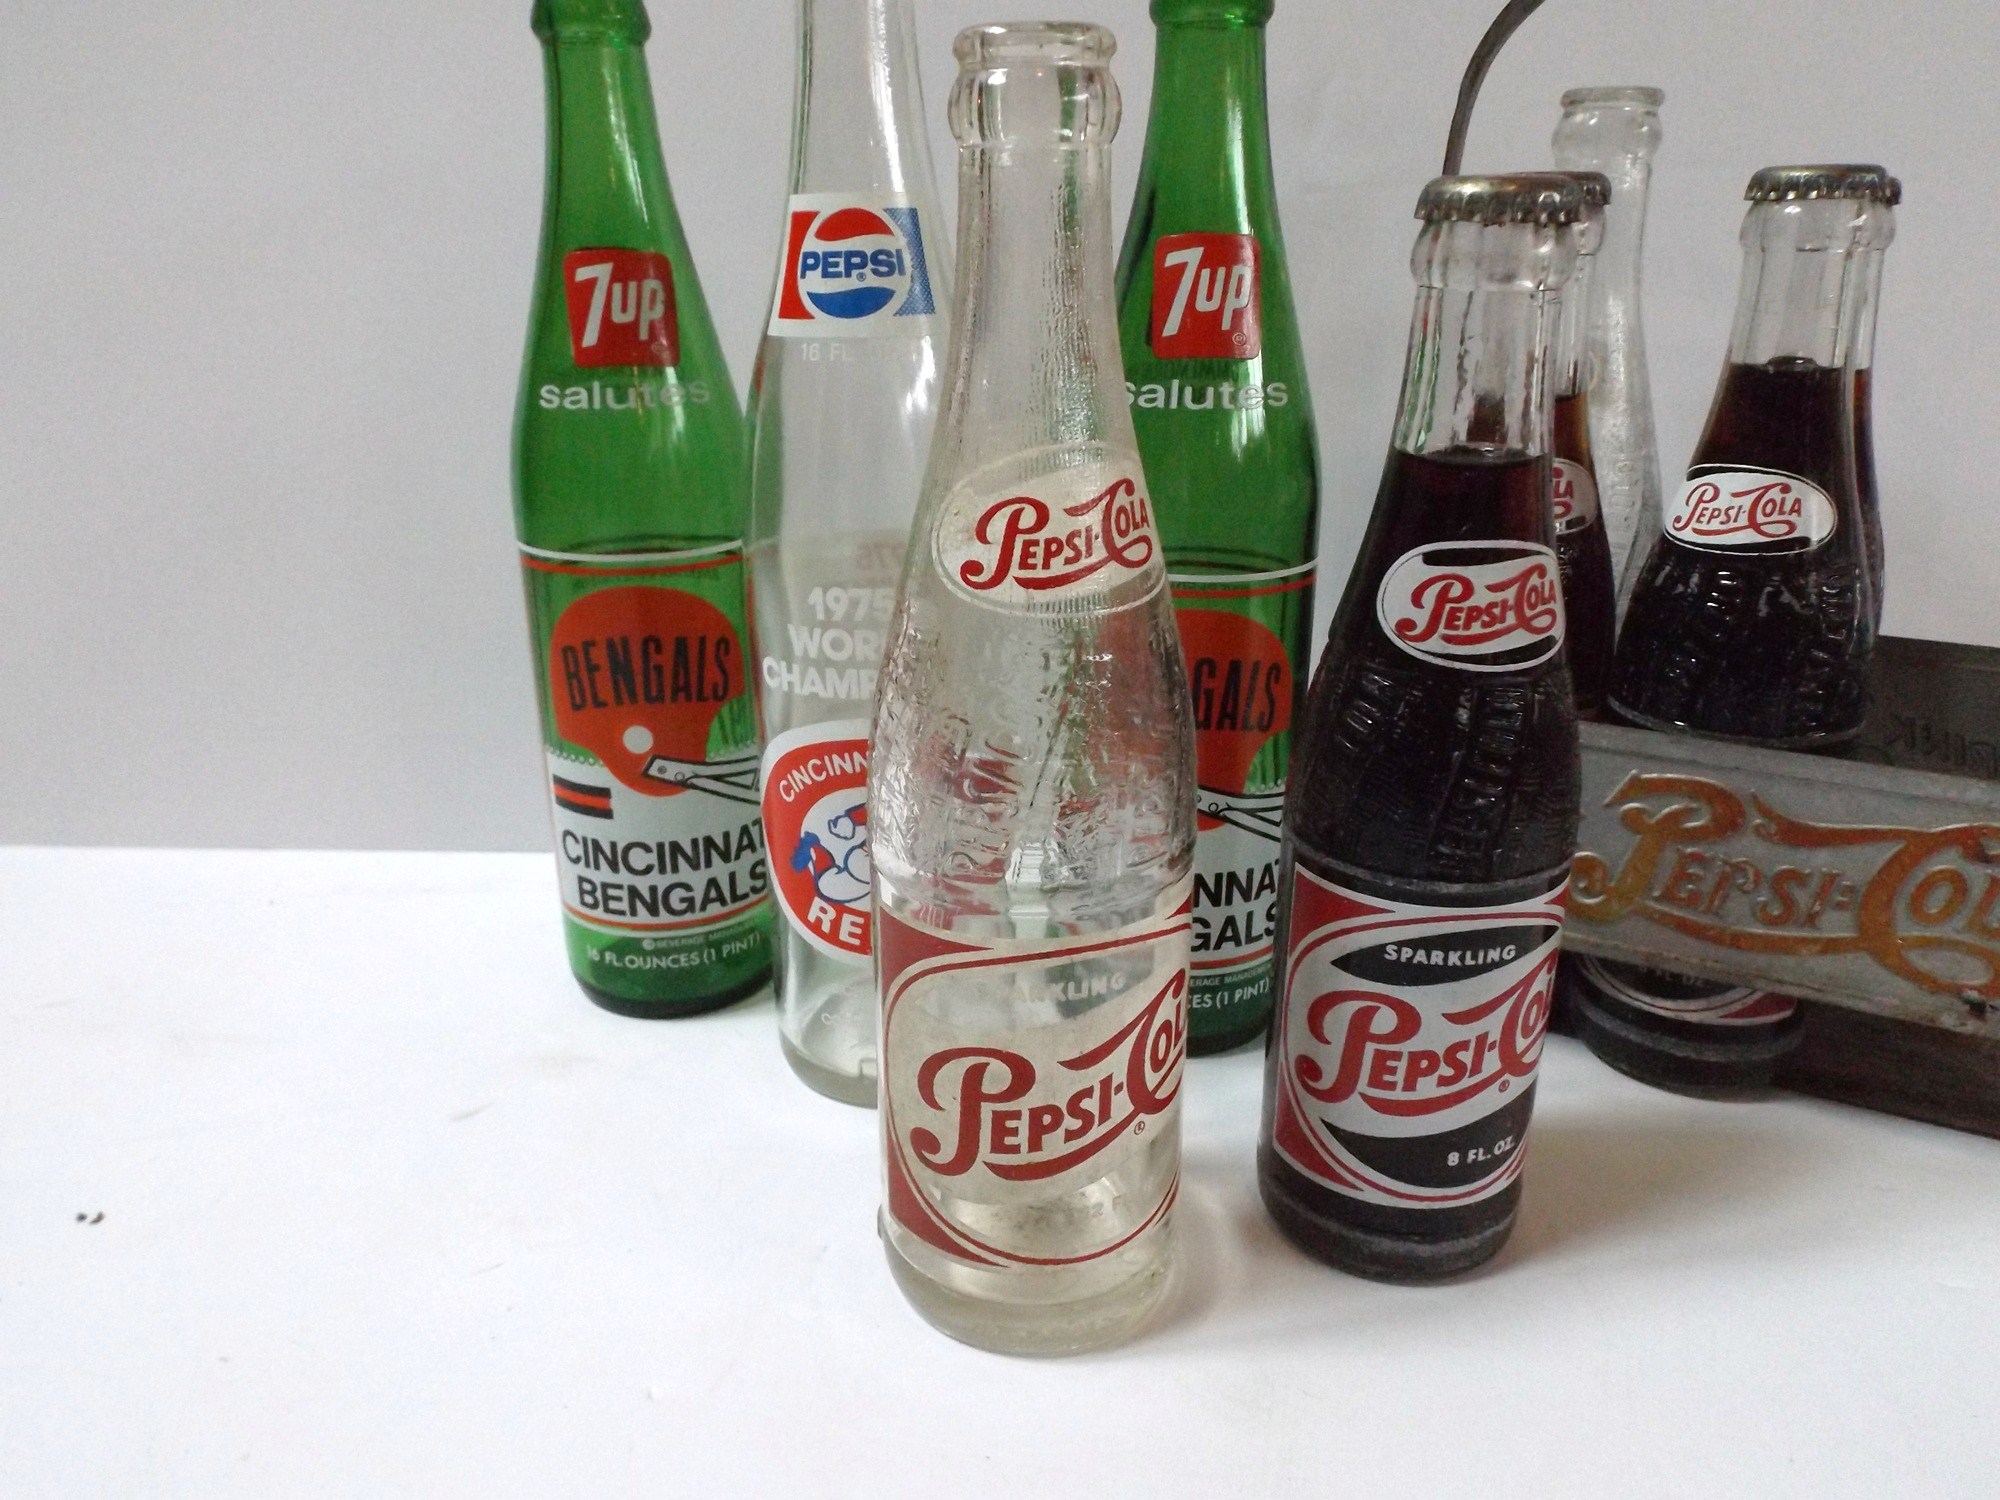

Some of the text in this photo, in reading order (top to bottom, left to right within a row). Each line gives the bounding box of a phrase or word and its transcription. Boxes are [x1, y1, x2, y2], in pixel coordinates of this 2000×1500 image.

[800, 247, 906, 279] PEPSI
[574, 262, 666, 348] 7up
[1163, 246, 1252, 338] 7up
[539, 380, 710, 410] salutes
[1124, 378, 1288, 410] salutes
[808, 586, 895, 622] 1975
[787, 623, 886, 662] WOR
[561, 634, 731, 713] BENGALS
[577, 858, 768, 918] BENGALS
[1193, 858, 1280, 908] NNA
[625, 950, 700, 970] OUNCES
[1384, 942, 1517, 967] SPARKLING
[1187, 992, 1213, 1009] ES
[1234, 975, 1270, 1004] PINT)
[1446, 1151, 1460, 1167] 8
